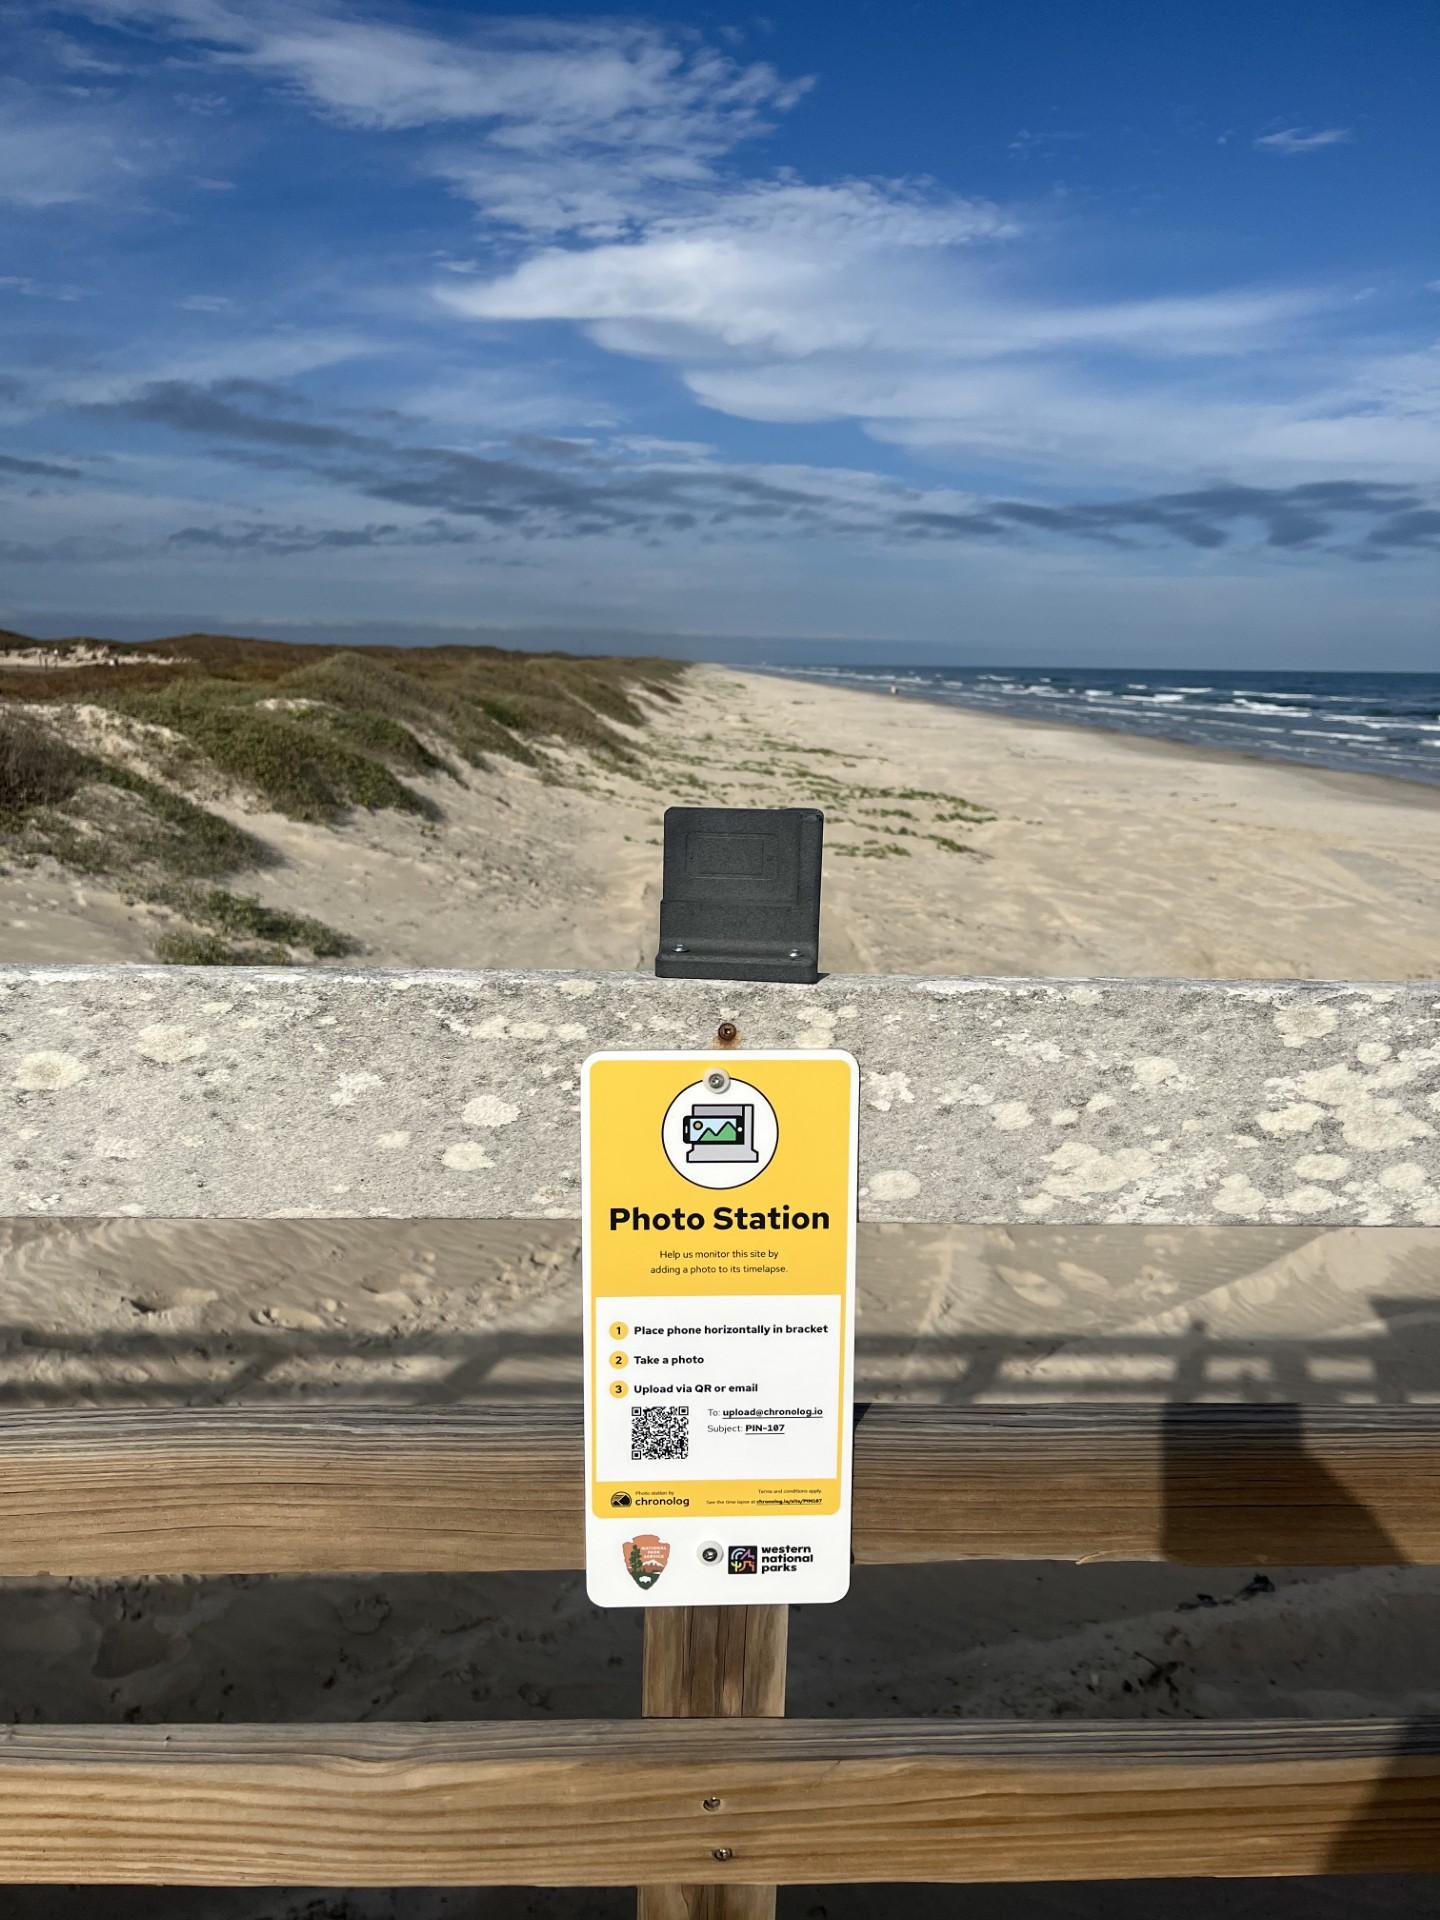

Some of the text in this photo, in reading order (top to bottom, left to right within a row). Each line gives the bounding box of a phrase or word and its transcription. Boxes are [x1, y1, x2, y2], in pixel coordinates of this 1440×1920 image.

[610, 1205, 830, 1231] Photo Station
[660, 1250, 680, 1260] Help
[768, 1249, 778, 1259] by
[651, 1266, 680, 1275] adding
[690, 1265, 716, 1275] photo
[743, 1265, 788, 1275] timelapse.
[634, 1326, 664, 1335] Place
[667, 1326, 701, 1336] phone
[705, 1325, 770, 1336] horizontally
[773, 1325, 782, 1333] in
[786, 1325, 828, 1334] bracket
[634, 1356, 659, 1364] Take
[671, 1356, 704, 1366] photo
[634, 1385, 673, 1395] Upload
[676, 1384, 692, 1393] via
[695, 1384, 712, 1393] QR
[729, 1384, 758, 1392] email
[723, 1408, 823, 1418] upload@chronolog.io
[707, 1425, 742, 1434] Subject:
[635, 1497, 690, 1507] chronolog
[762, 1545, 811, 1554] western
[762, 1554, 814, 1563] national
[762, 1564, 797, 1574] parks
